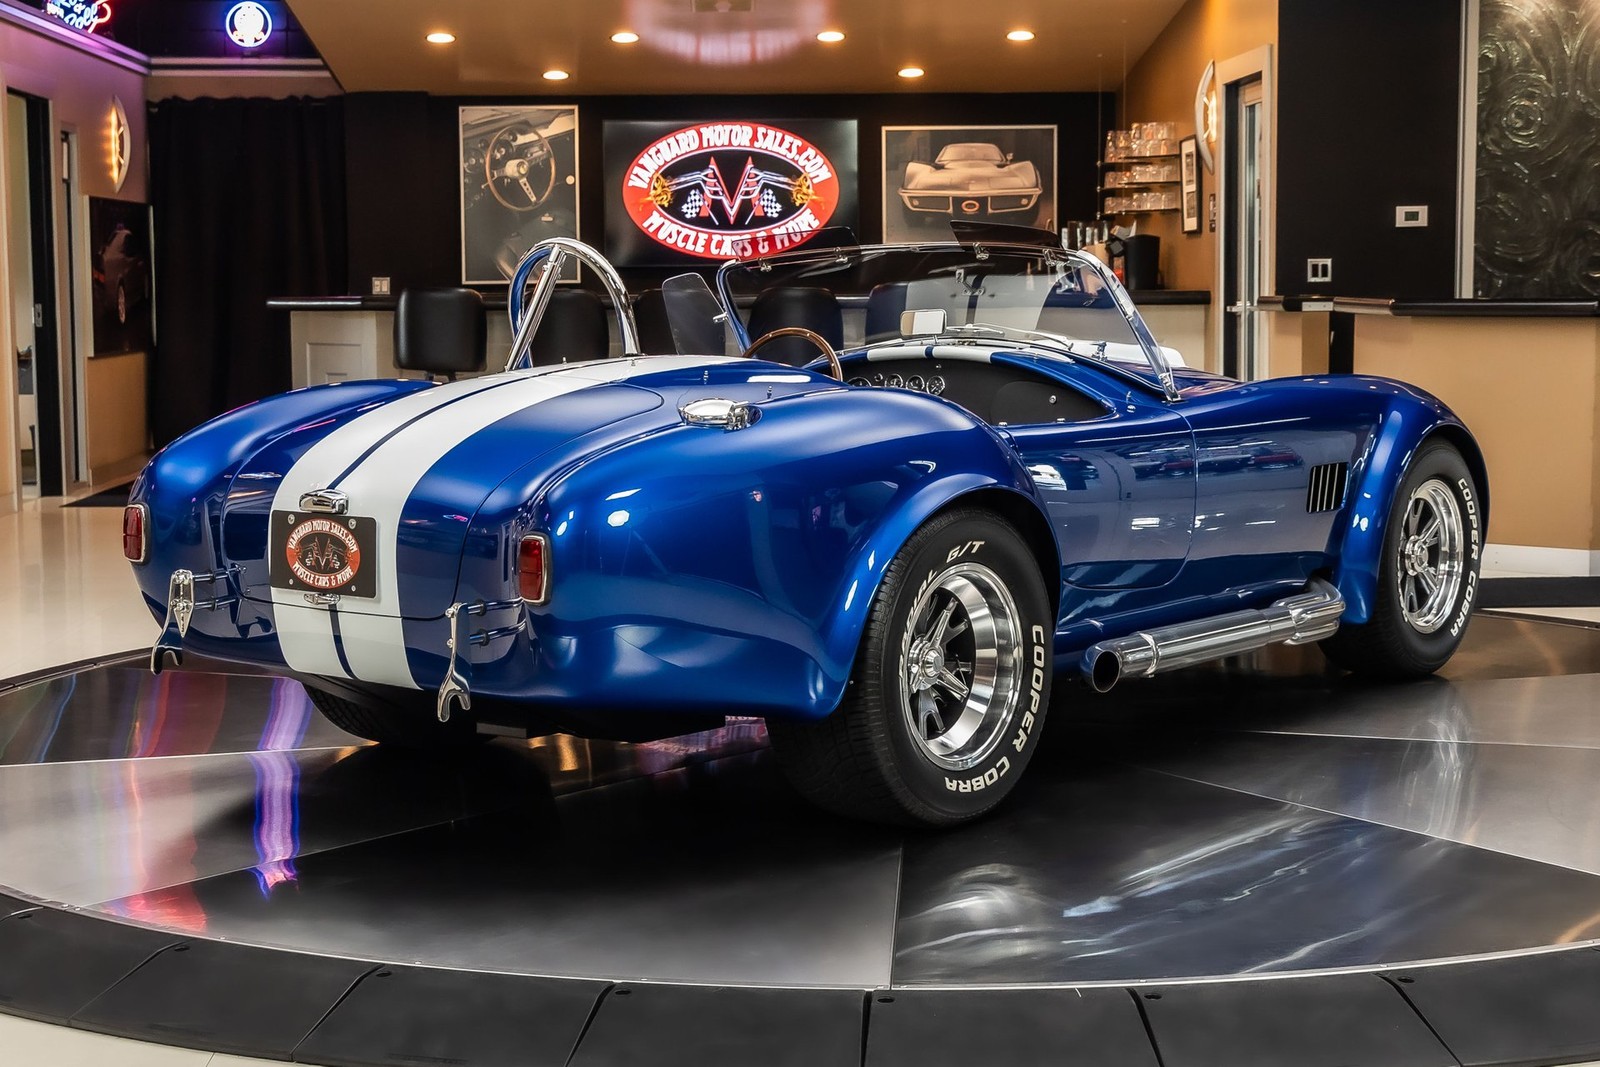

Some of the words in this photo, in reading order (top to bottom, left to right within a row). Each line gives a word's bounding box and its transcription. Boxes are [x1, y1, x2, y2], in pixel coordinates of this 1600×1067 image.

[628, 129, 699, 189] VANGUARD
[700, 125, 753, 148] MOTOR
[753, 126, 832, 184] SALES.COM
[642, 210, 707, 253] MUSCLE
[709, 233, 753, 257] CARS
[756, 232, 769, 252] &
[771, 208, 820, 250] MORE
[288, 521, 313, 550] VANGUARD
[311, 520, 331, 532] MOTOR
[1457, 478, 1478, 561] COOPER
[292, 561, 315, 584] MUSCLE
[314, 575, 330, 587] CARS
[336, 565, 354, 585] MORE
[946, 540, 985, 563] G/T
[1450, 570, 1477, 637] COBRA
[1012, 624, 1045, 753] COOPER
[944, 755, 1011, 793] COBRA
